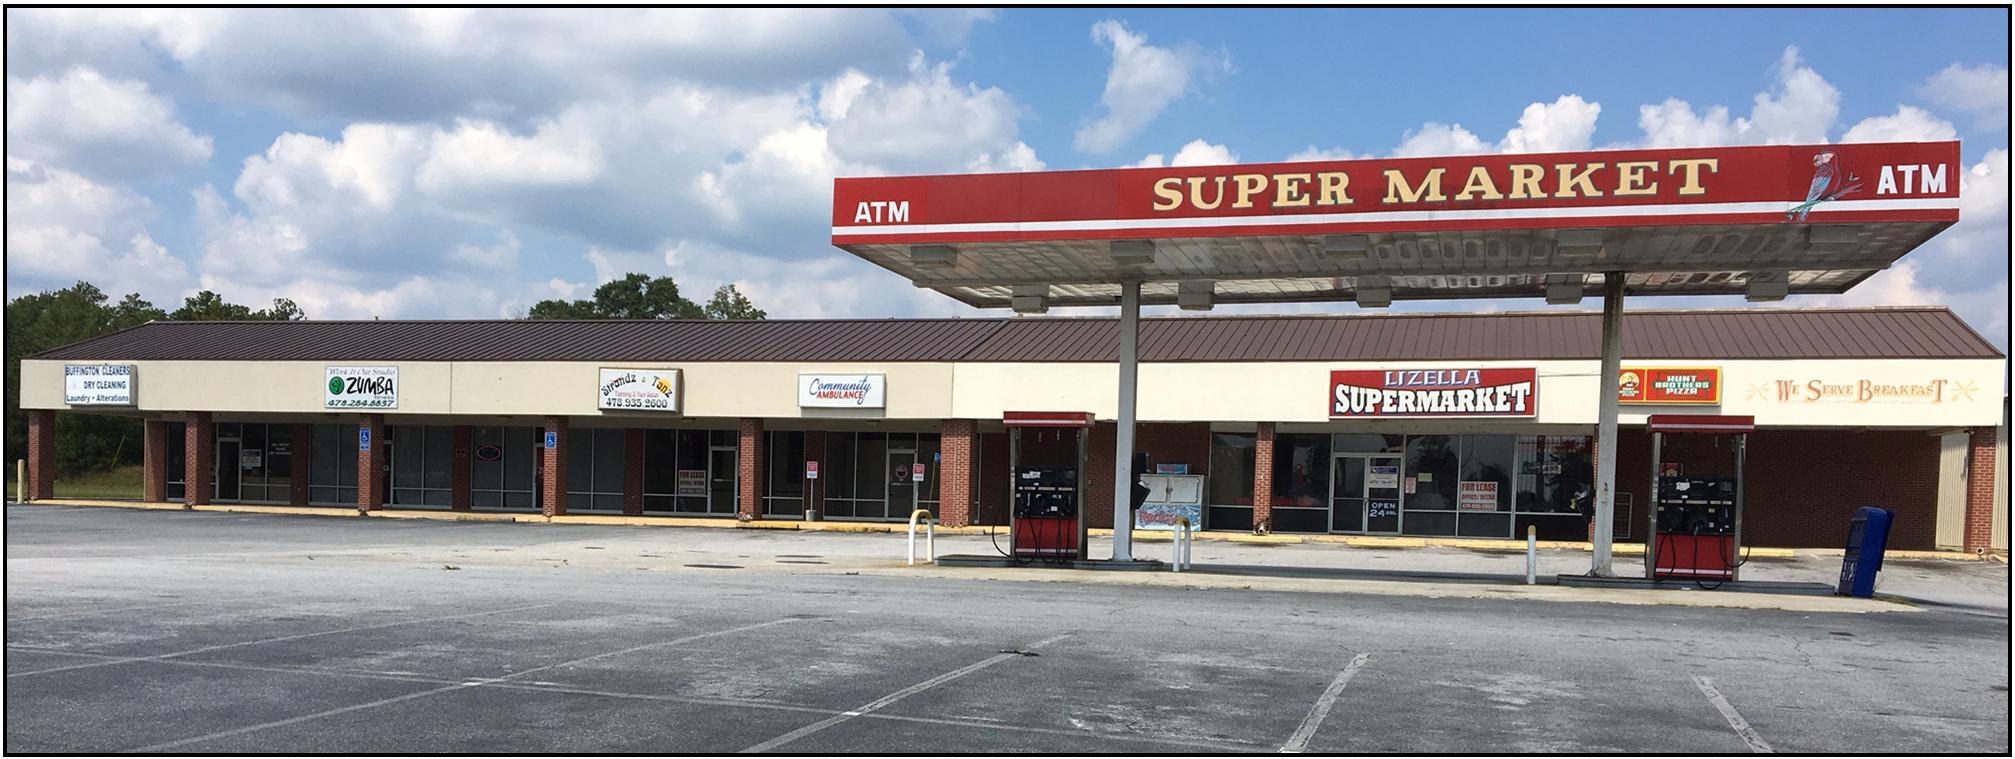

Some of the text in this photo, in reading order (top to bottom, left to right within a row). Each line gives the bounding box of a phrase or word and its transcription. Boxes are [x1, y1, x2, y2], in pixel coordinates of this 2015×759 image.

[1153, 158, 1718, 211] SUPER MARKET
[1876, 163, 1947, 195] ATM
[854, 200, 909, 223] ATM
[65, 365, 130, 376] BUFFINGTON CLEANERS
[1384, 369, 1480, 387] LIZELLA
[84, 380, 126, 389] DRY CLEANING
[346, 376, 394, 395] ZUMBA
[601, 373, 637, 396] Strandz
[651, 375, 673, 398] Tanz
[809, 375, 872, 405] Community
[66, 394, 129, 403] Laundry Alterations
[606, 398, 668, 408] 478.935.2600
[816, 391, 864, 400] AMBULANCE
[1334, 380, 1531, 414] SUPERMARKET
[1461, 483, 1496, 492] FOR LEASE
[1369, 509, 1385, 518] 24
